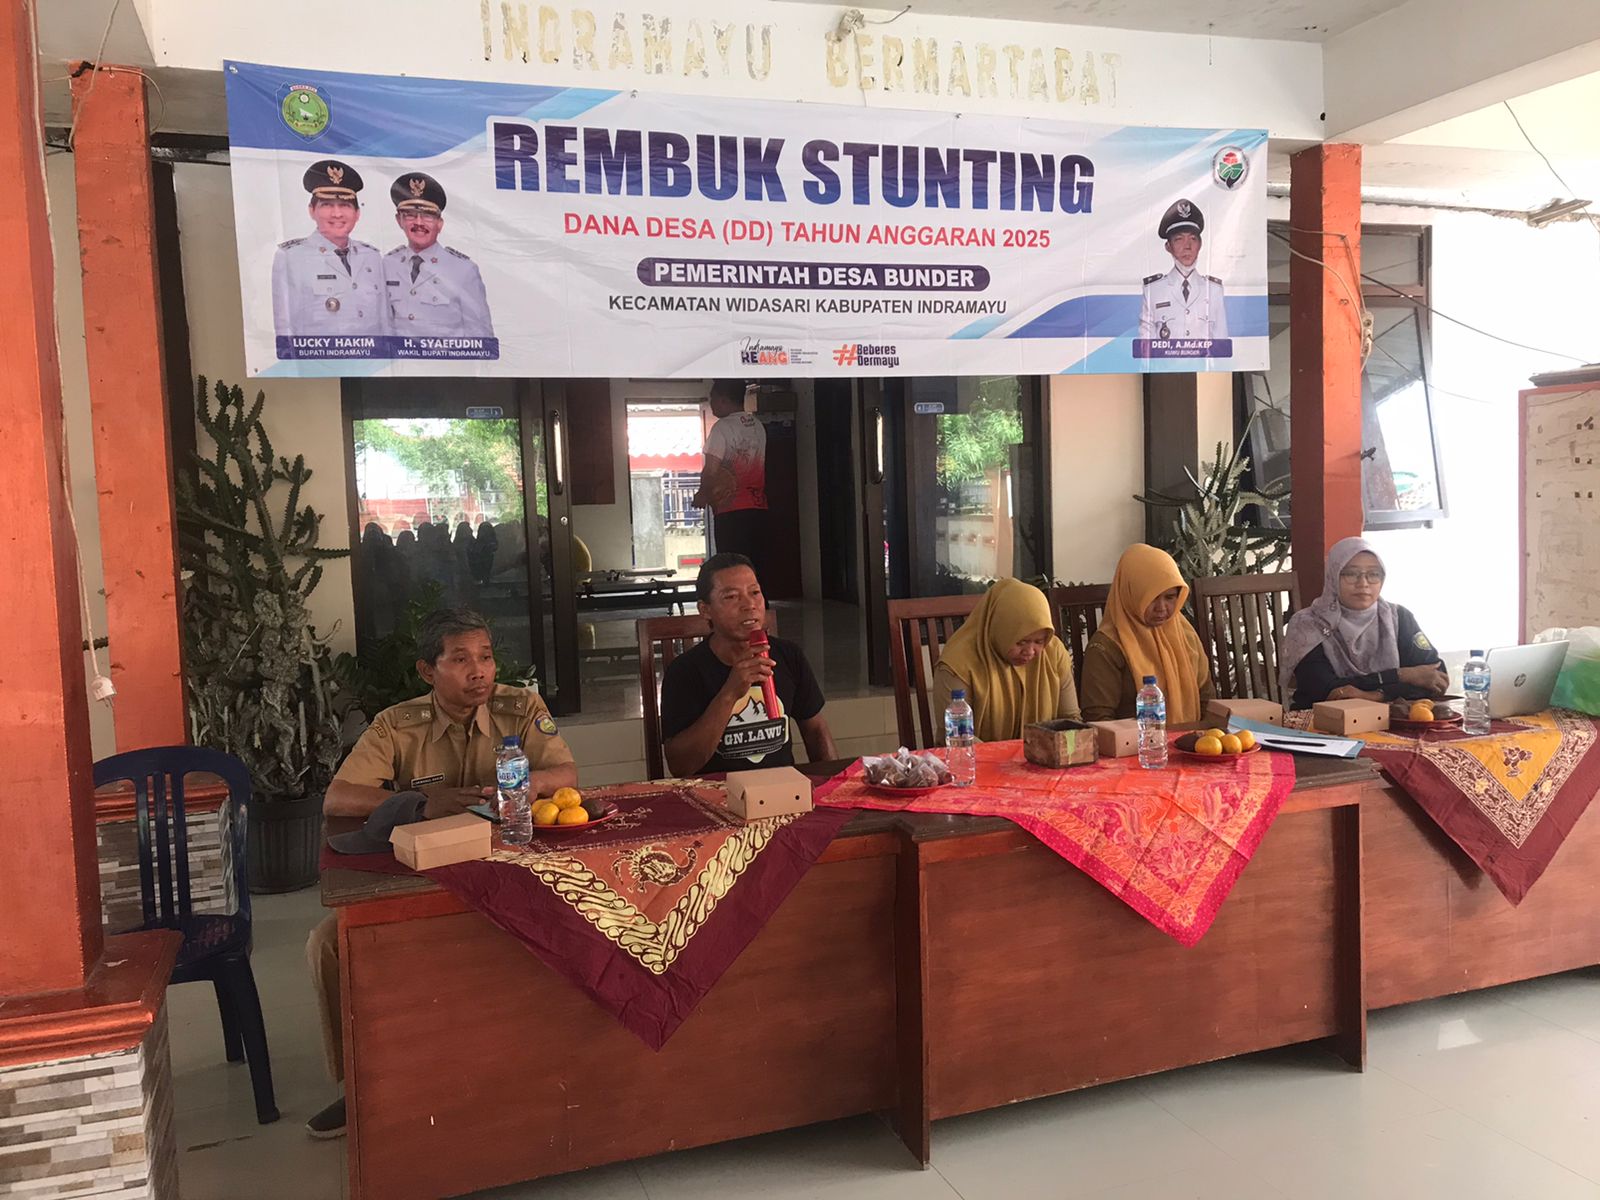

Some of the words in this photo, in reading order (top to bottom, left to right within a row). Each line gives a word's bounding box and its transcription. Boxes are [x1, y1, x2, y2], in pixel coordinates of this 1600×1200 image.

[480, 0, 773, 81] INDRAMAYU
[493, 122, 788, 202] REMBUK
[801, 139, 1095, 214] STUNTING
[564, 213, 639, 236] DANA
[646, 217, 715, 239] DESA
[722, 219, 773, 246] (DD)
[781, 221, 861, 244] TAHUN
[866, 224, 996, 247] ANGGARAN
[1003, 229, 1051, 248] 2025
[654, 262, 810, 285] PEMERINTAH
[818, 267, 878, 286] DESA
[884, 268, 975, 287] BUNDER
[608, 296, 720, 312] KECAMATAN
[726, 297, 810, 313] WIDASARI
[816, 299, 913, 314] KABUPATEN
[918, 300, 1007, 315] INDRAMAYU
[293, 338, 330, 348] LUCKY
[335, 338, 375, 348] HAKIM
[404, 339, 416, 348] H.
[420, 339, 483, 349] SYAEFUDIN
[857, 344, 896, 355] Beberes
[1152, 341, 1173, 350] DEDI,
[741, 351, 788, 364] REANG
[857, 356, 899, 368] Dermayu
[723, 725, 783, 746] GN.LAWU
